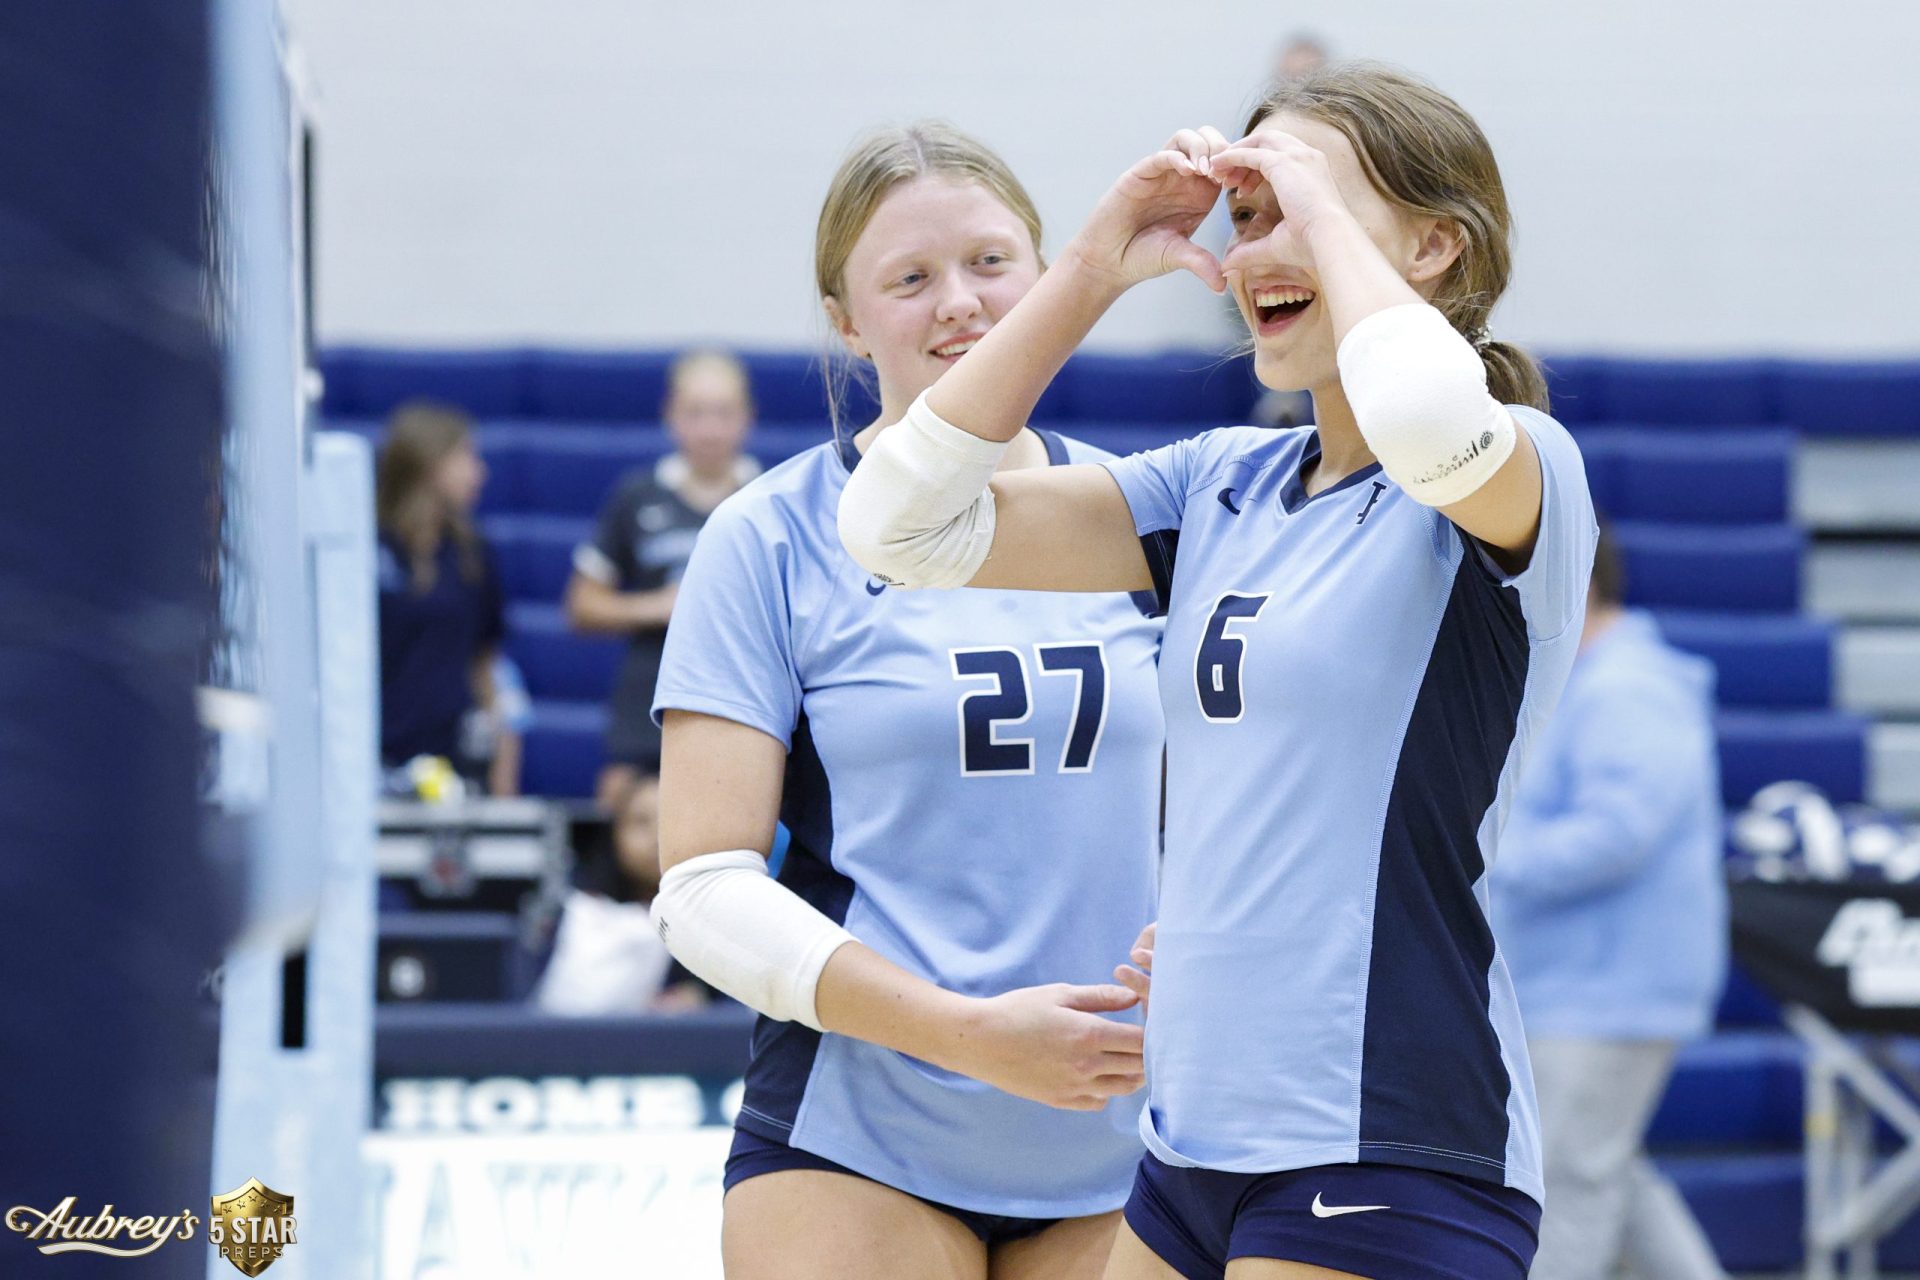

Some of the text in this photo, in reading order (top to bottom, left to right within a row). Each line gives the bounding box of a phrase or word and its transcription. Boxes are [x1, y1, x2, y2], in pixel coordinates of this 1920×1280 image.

[948, 640, 1110, 777] 27
[1193, 590, 1274, 724] 6
[382, 1076, 704, 1131] HOME
